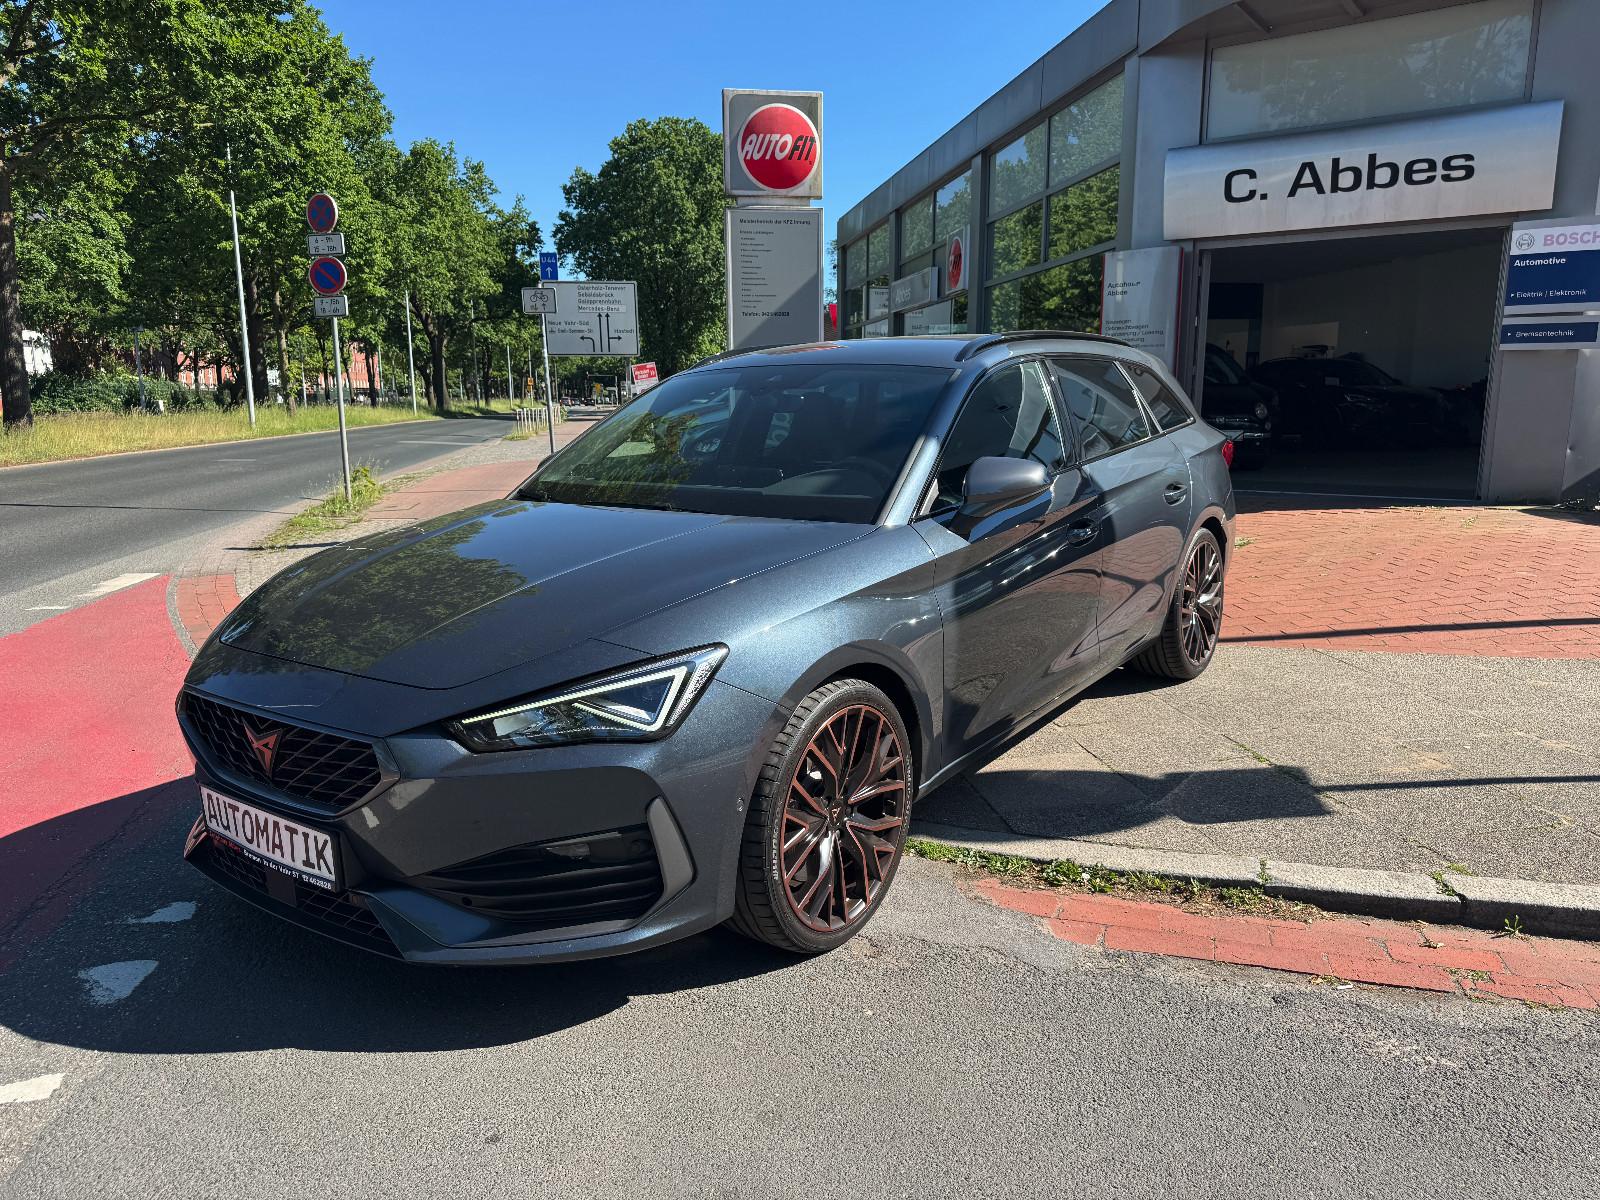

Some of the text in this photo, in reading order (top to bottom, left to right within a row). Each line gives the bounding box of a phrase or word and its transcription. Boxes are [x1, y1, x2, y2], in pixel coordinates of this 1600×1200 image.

[741, 133, 816, 160] AUTOFIT
[1224, 153, 1475, 203] C. Abbes
[1514, 256, 1567, 267] Automotive
[1549, 289, 1586, 297] Elektronik
[1516, 329, 1575, 338] Bremsentechnik
[206, 792, 333, 876] AUTOMATIK
